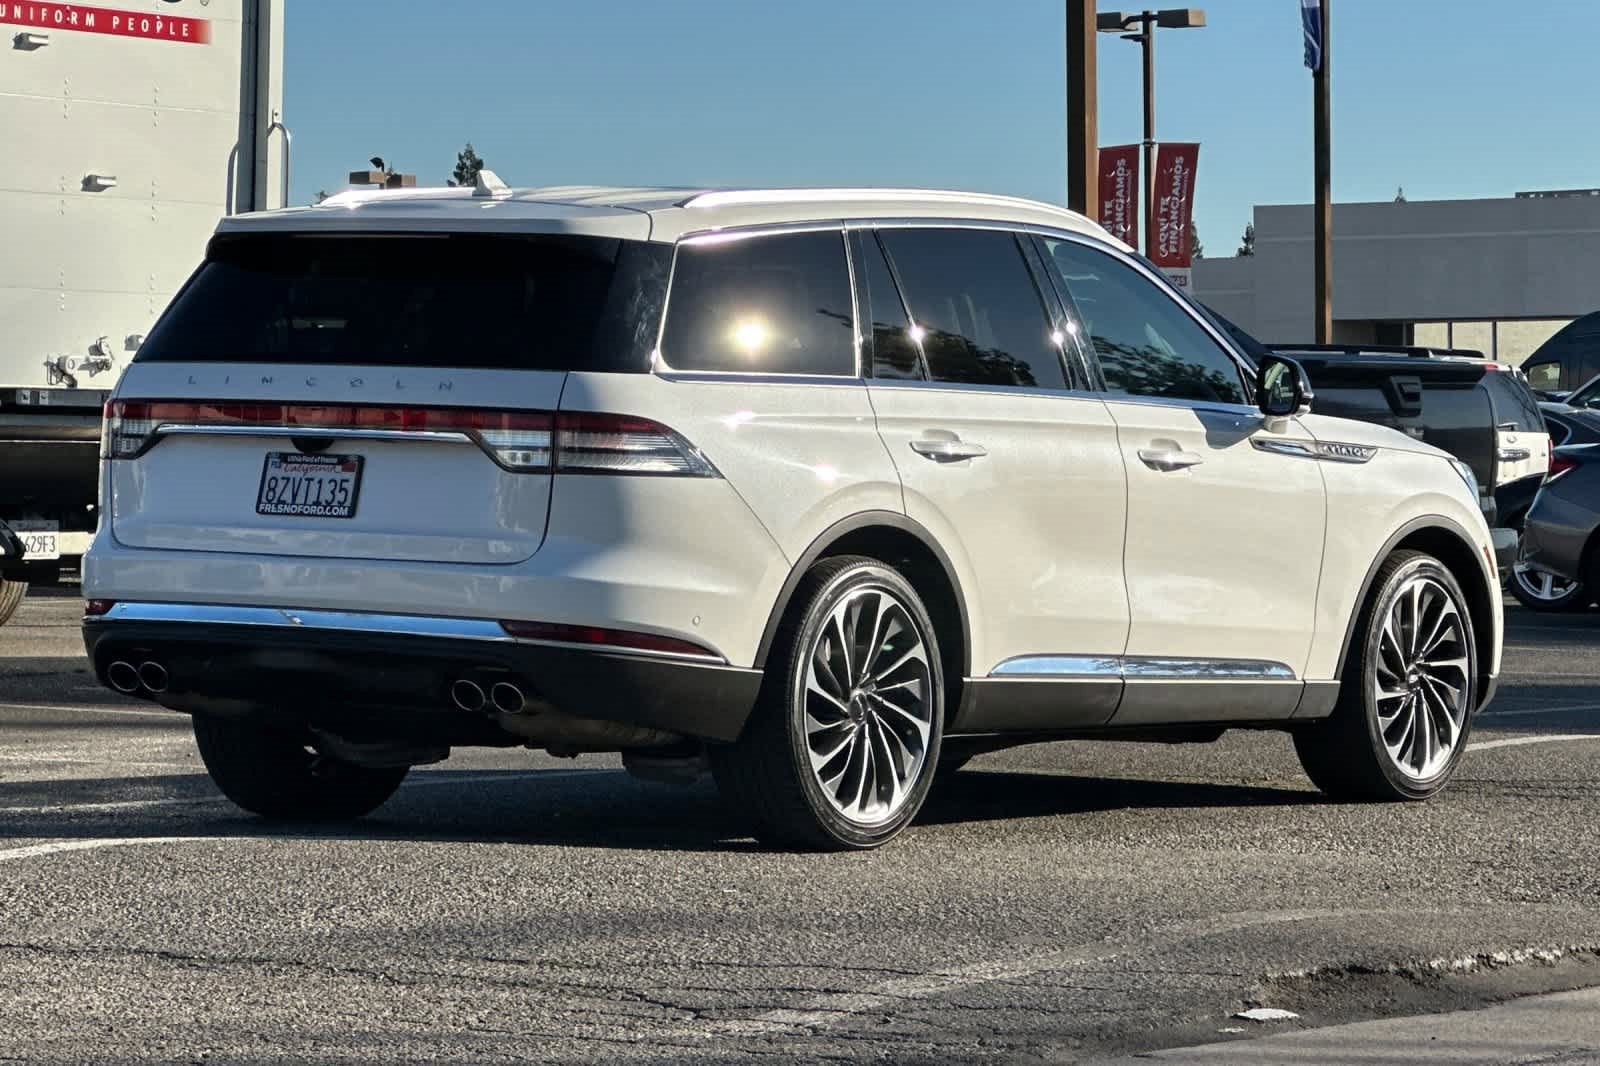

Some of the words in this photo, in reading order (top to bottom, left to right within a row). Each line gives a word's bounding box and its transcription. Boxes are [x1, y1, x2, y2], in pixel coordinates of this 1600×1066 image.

[0, 5, 95, 27] UNIFORM
[112, 17, 189, 37] PEOPLE
[1115, 158, 1126, 240] NANCIAMOS
[1169, 156, 1184, 253] FINANCIAMOS
[187, 375, 454, 391] LINCOLN
[1322, 444, 1369, 457] AVIATOR
[265, 476, 350, 506] 8ZVT135
[259, 503, 349, 516] FRESNOFORD.COM
[19, 535, 56, 553] 629F3
